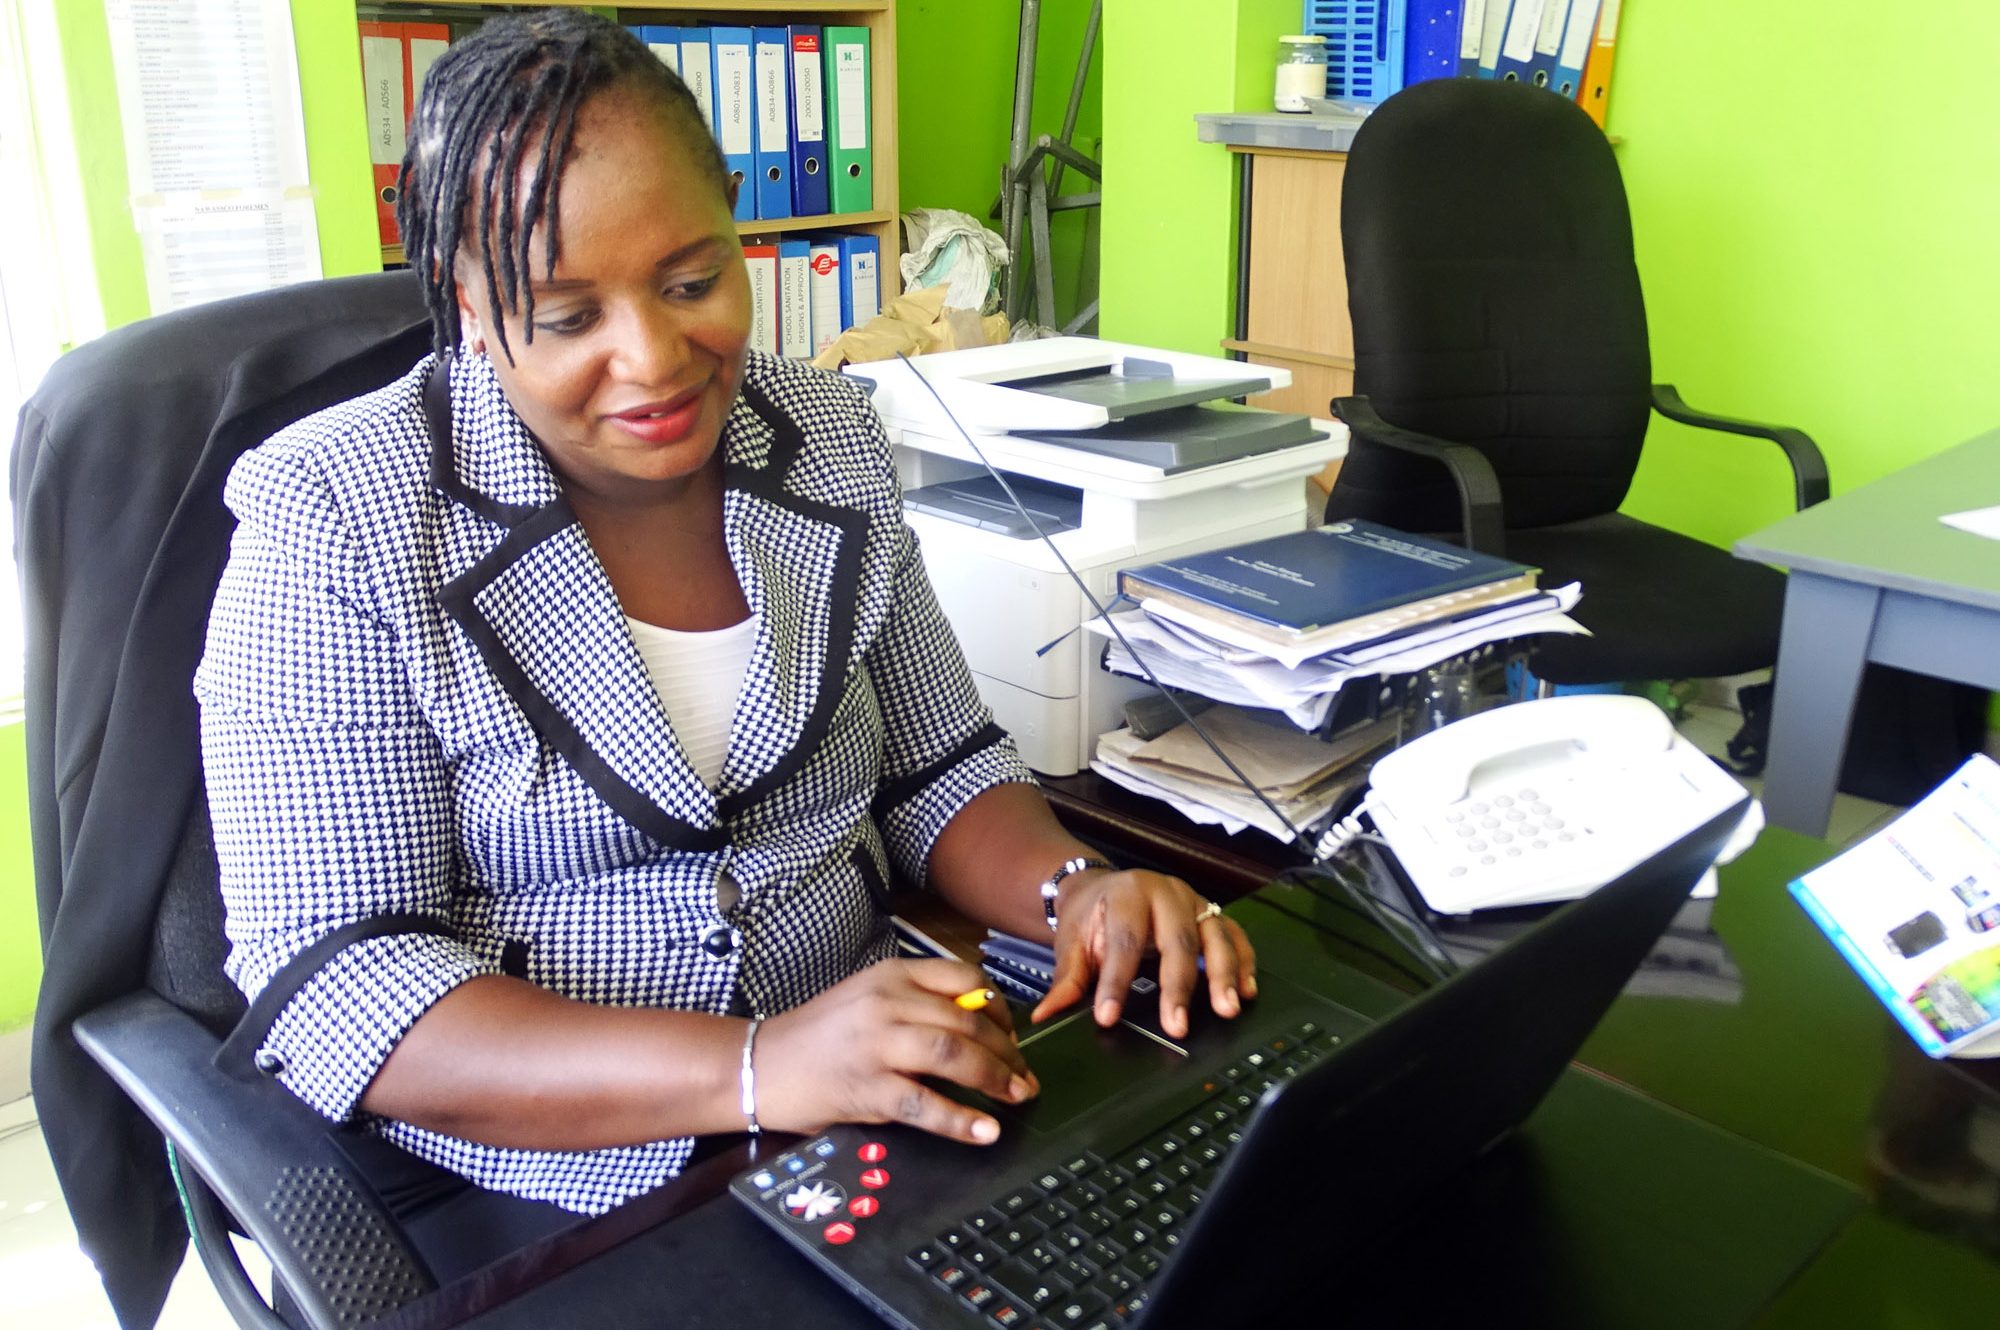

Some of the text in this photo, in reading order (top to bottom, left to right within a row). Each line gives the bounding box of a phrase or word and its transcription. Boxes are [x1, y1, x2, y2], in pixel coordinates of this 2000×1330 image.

[381, 79, 390, 109] A0566
[695, 71, 703, 97] A0800
[733, 70, 741, 124] A0801-A0833
[383, 117, 392, 146] A0534
[755, 267, 763, 314] SANITATION
[784, 267, 792, 313] SANITATION
